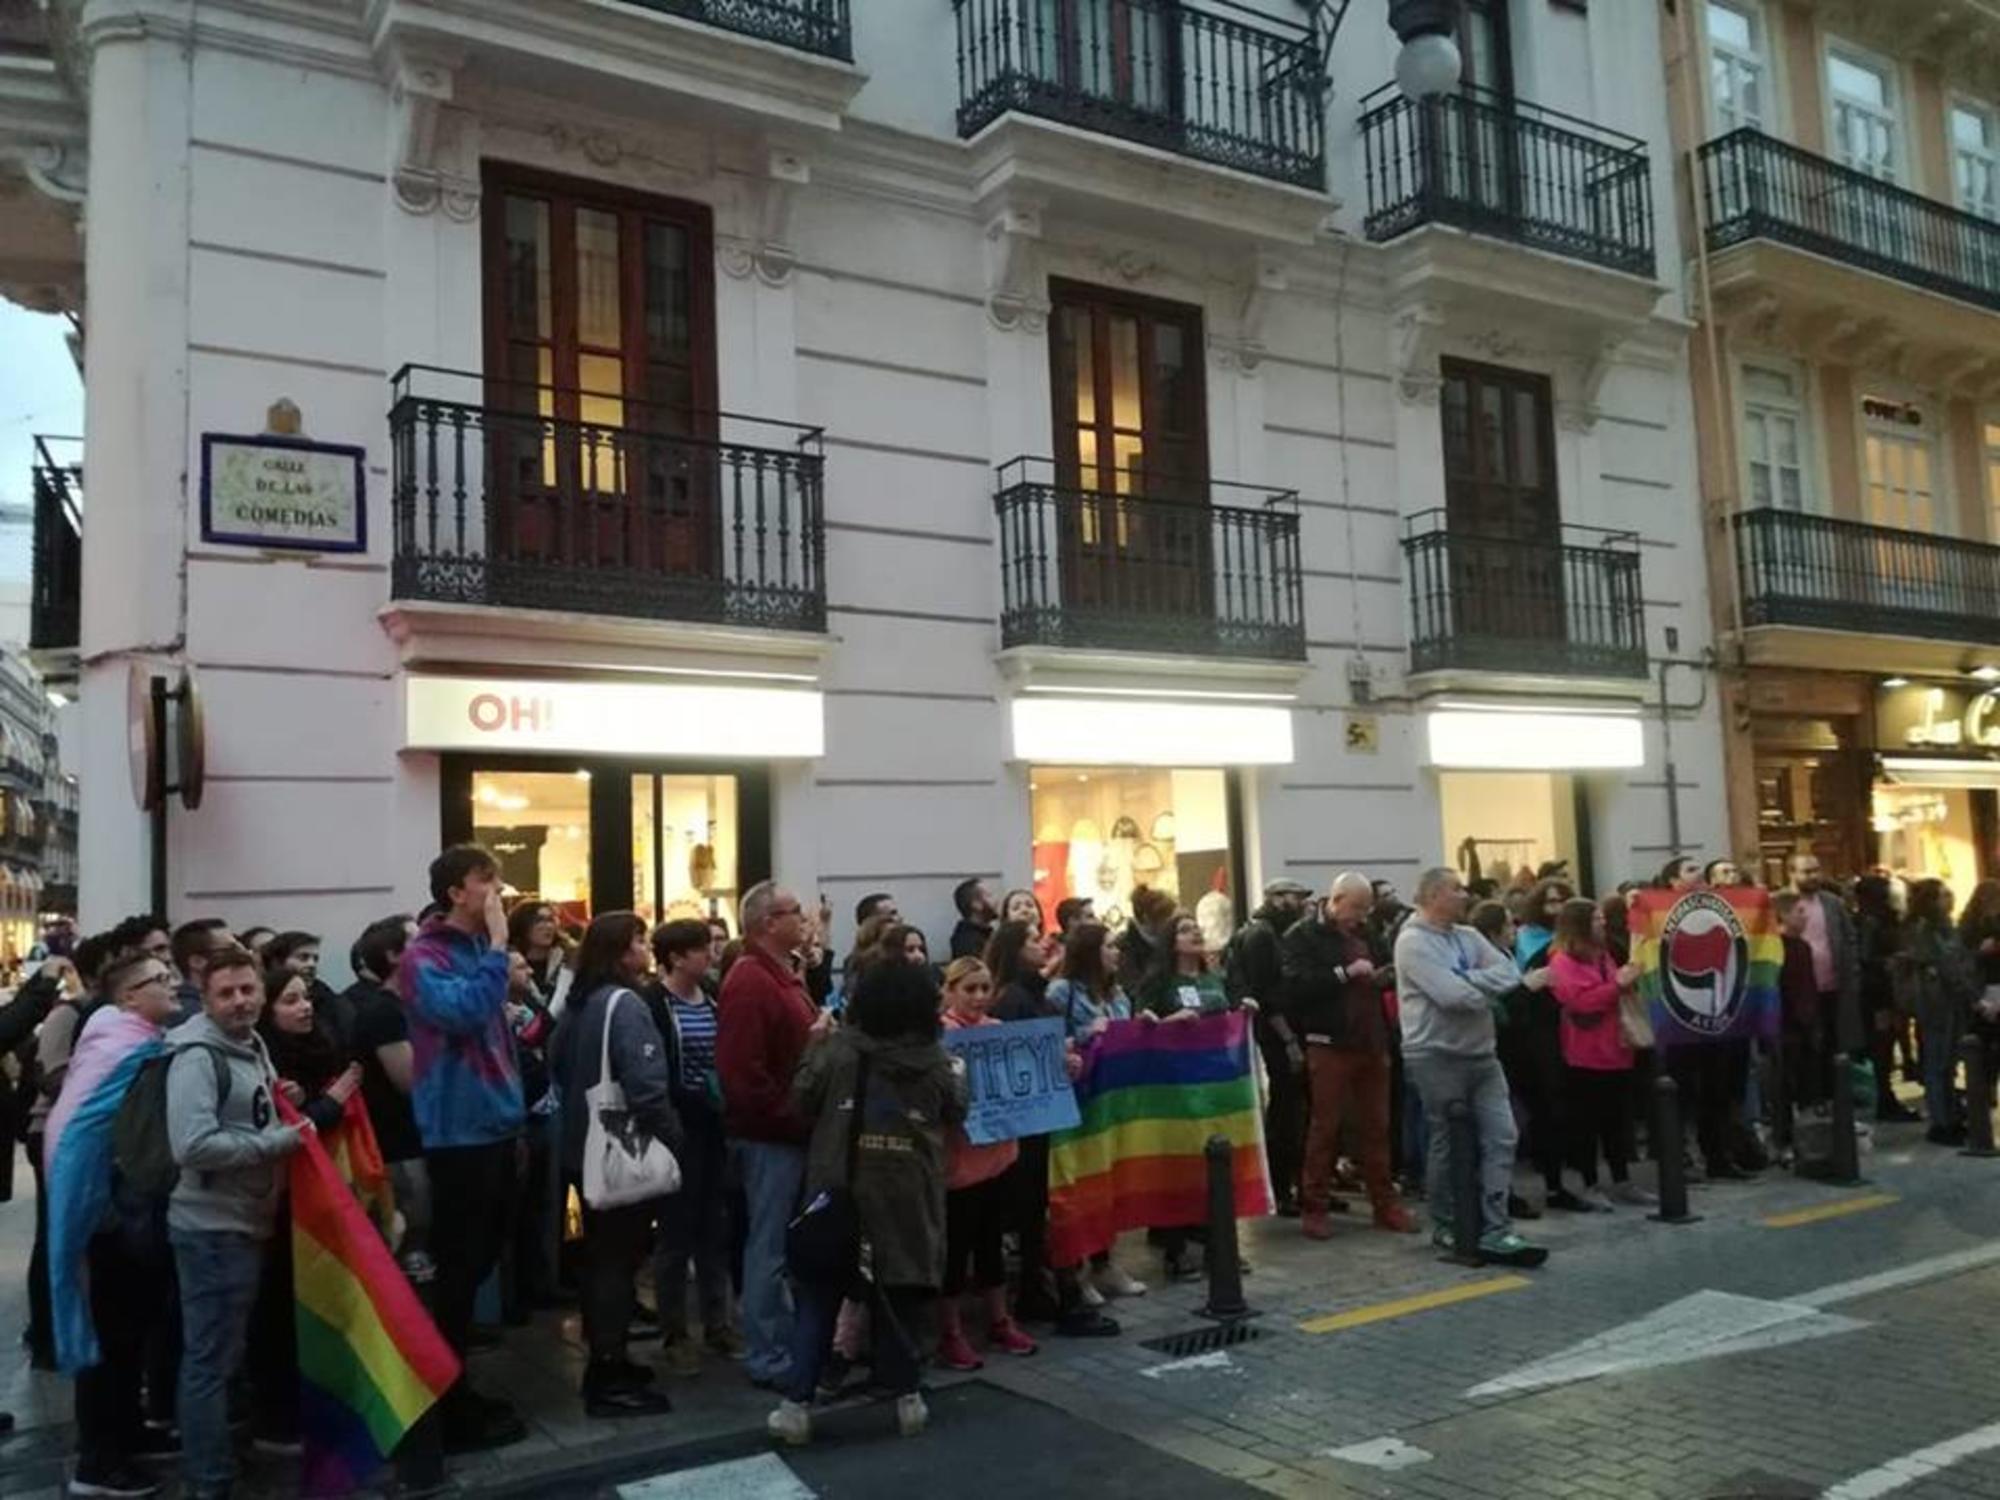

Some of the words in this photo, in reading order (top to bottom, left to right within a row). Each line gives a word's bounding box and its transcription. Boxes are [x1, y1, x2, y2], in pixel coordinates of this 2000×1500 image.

[263, 459, 304, 473] CALLE
[256, 478, 276, 492] DE
[282, 480, 313, 495] LAS
[236, 503, 338, 528] COMEDIAS
